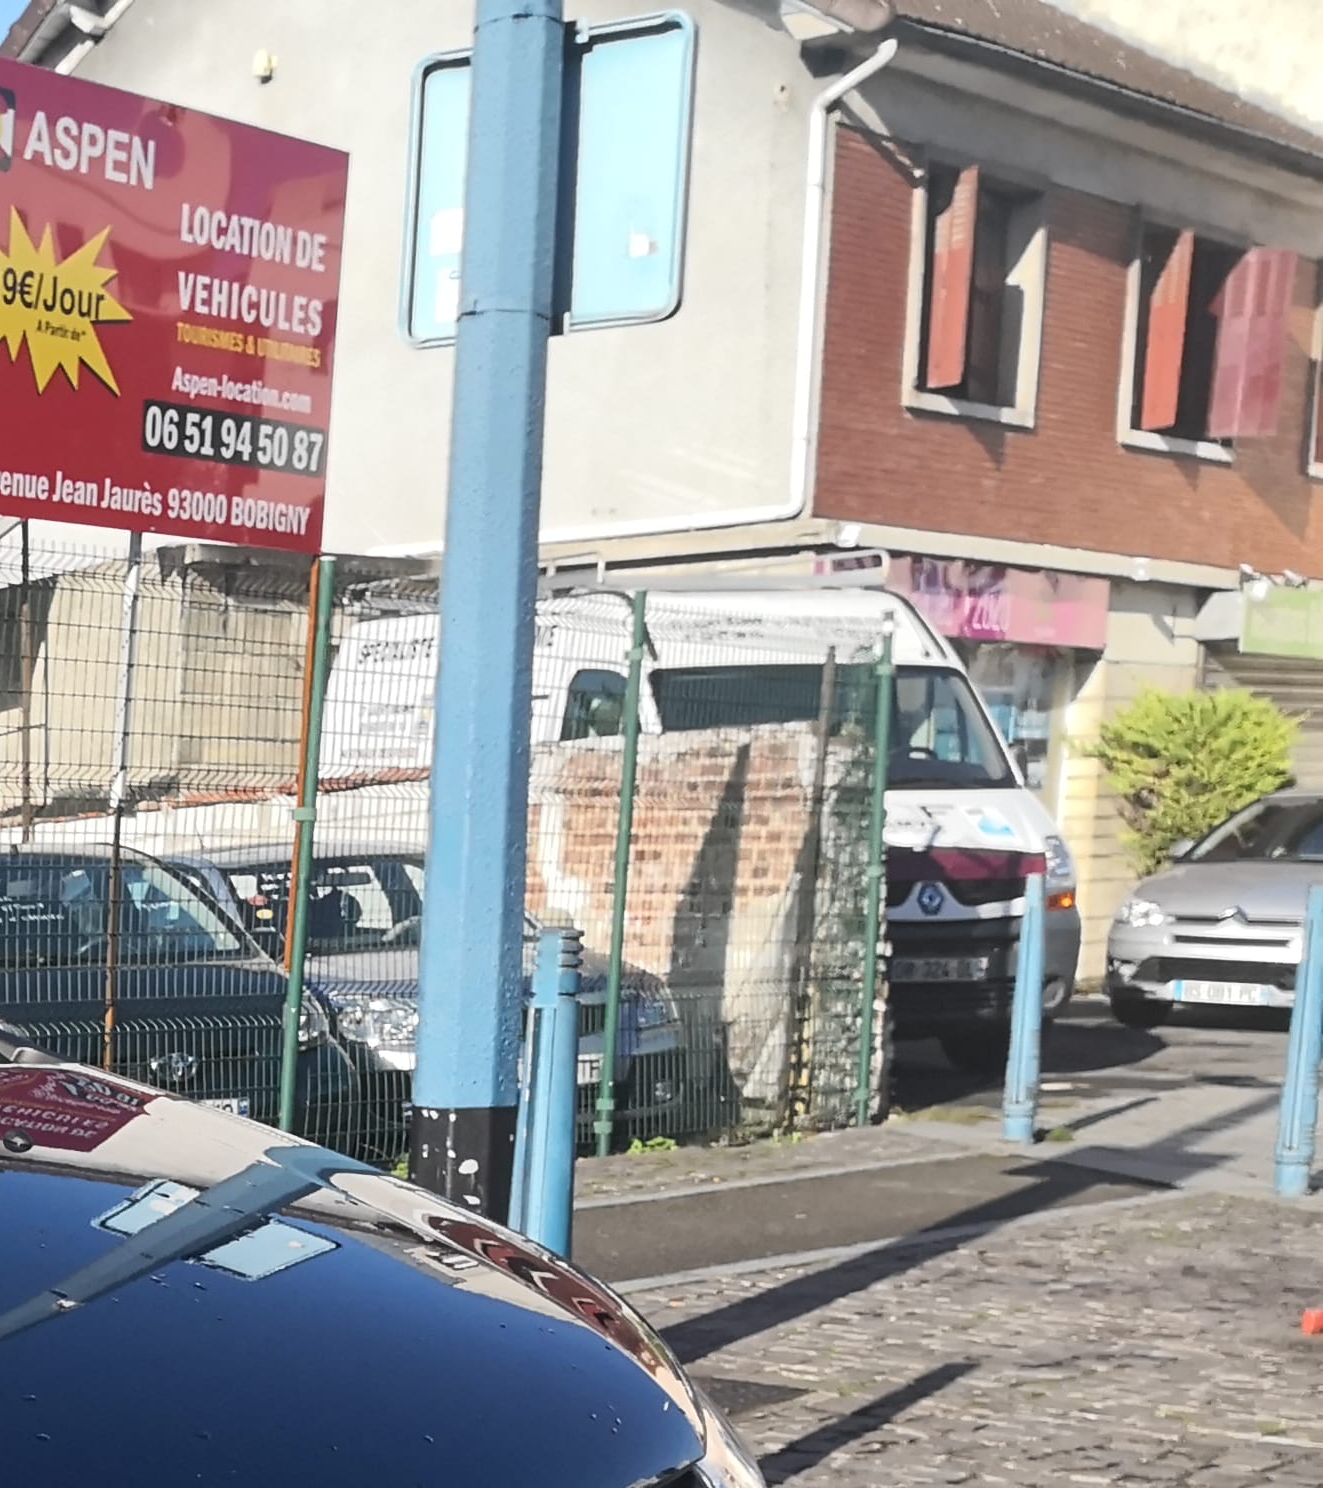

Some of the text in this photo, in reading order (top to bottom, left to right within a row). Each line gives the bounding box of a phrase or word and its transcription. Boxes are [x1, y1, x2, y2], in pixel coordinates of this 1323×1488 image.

[23, 111, 155, 190] ASPEN
[179, 203, 327, 272] LOCATION DE
[177, 271, 323, 337] VEHICULES
[170, 365, 313, 414] Aspen-location.com
[144, 405, 324, 473] 06 51 94 50 87
[52, 470, 99, 507] Jean
[101, 474, 163, 517] Jaurès
[166, 489, 227, 525] 93000
[230, 495, 311, 536] BOBIGNY
